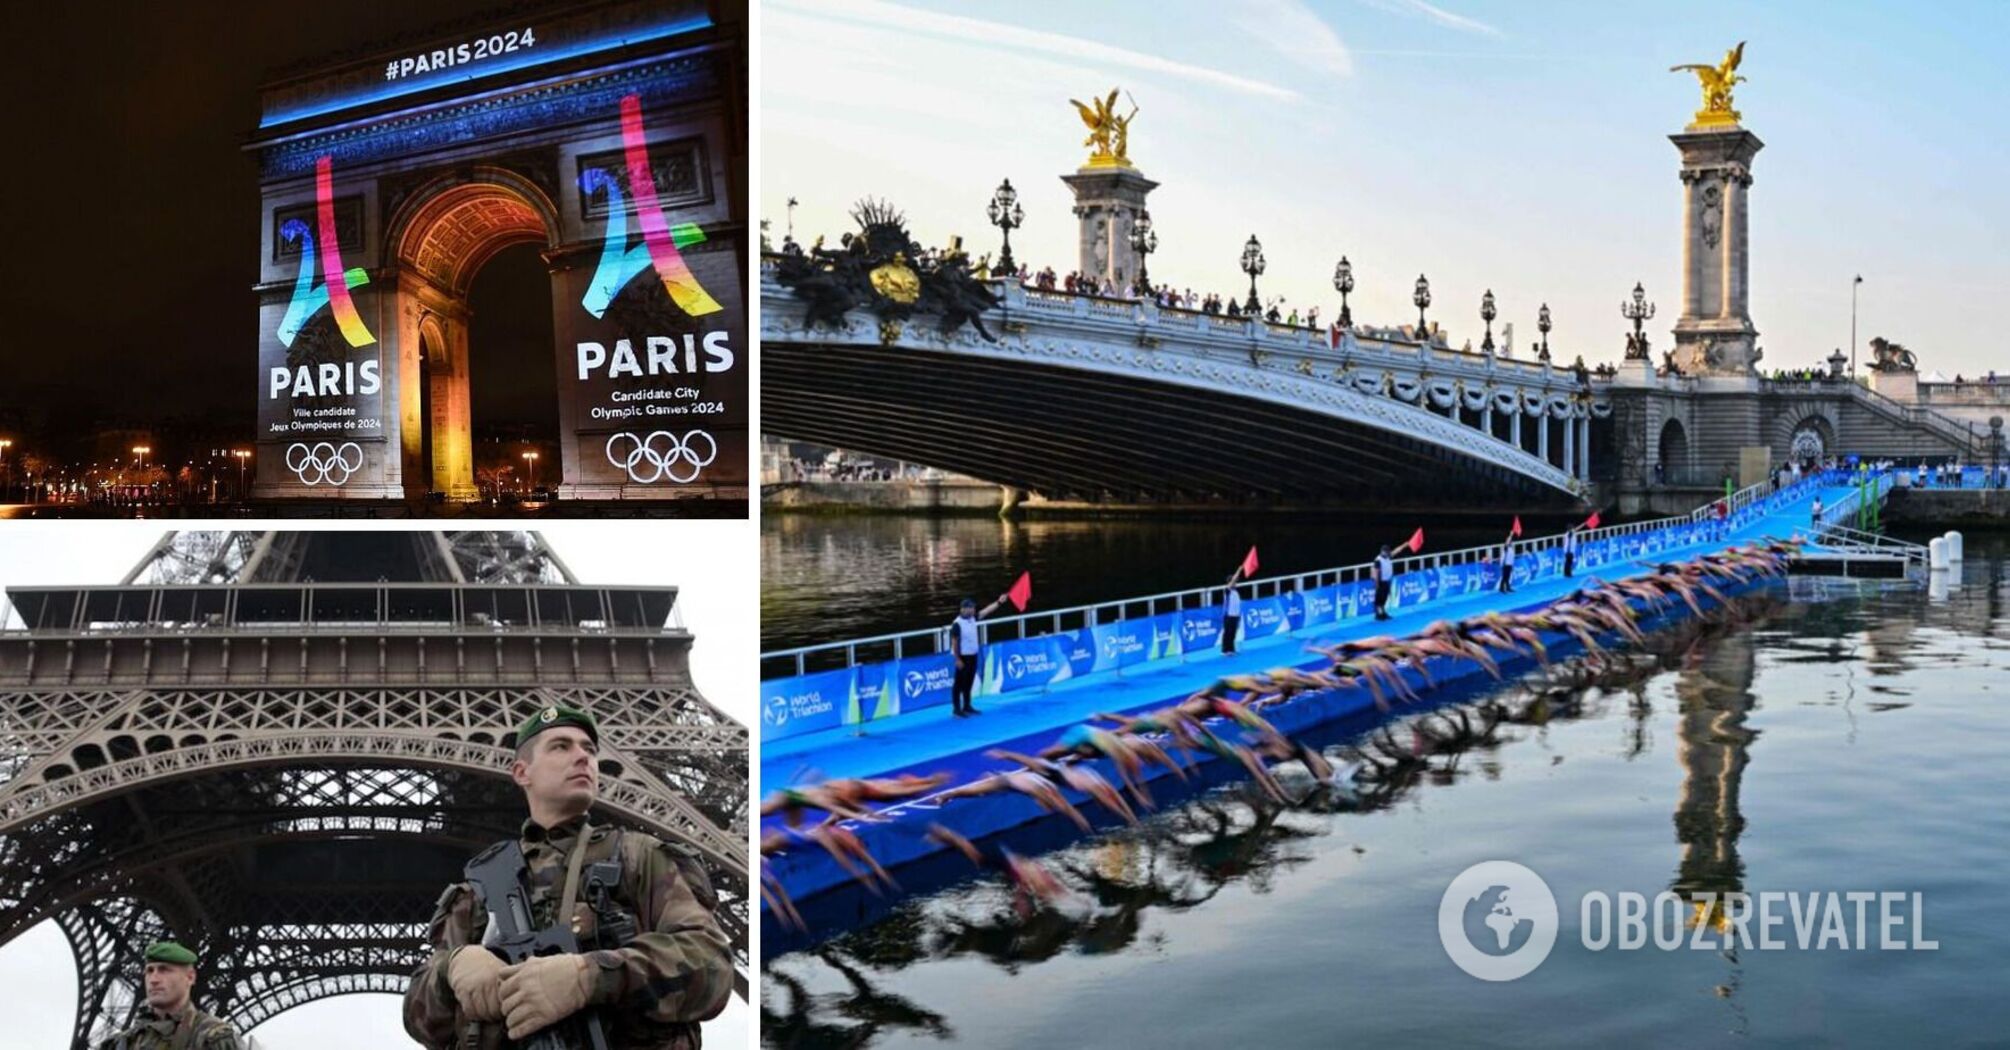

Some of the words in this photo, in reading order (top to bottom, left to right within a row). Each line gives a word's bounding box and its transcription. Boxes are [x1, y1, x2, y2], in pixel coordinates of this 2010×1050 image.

[385, 27, 536, 80] #PARIS2024
[577, 330, 735, 380] PARIS
[270, 360, 381, 399] PARIS
[611, 389, 672, 402] Candidate
[674, 387, 700, 400] City
[293, 408, 311, 417] Ville
[313, 407, 356, 417] candidate
[591, 406, 643, 420] Olympic
[645, 404, 688, 416] Games
[691, 401, 725, 414] 2024
[270, 423, 289, 432] Jeux
[291, 421, 342, 432] Olympiques
[344, 420, 356, 429] de
[358, 419, 381, 428] 2024
[790, 691, 821, 706] World
[789, 701, 833, 719] Triathlon
